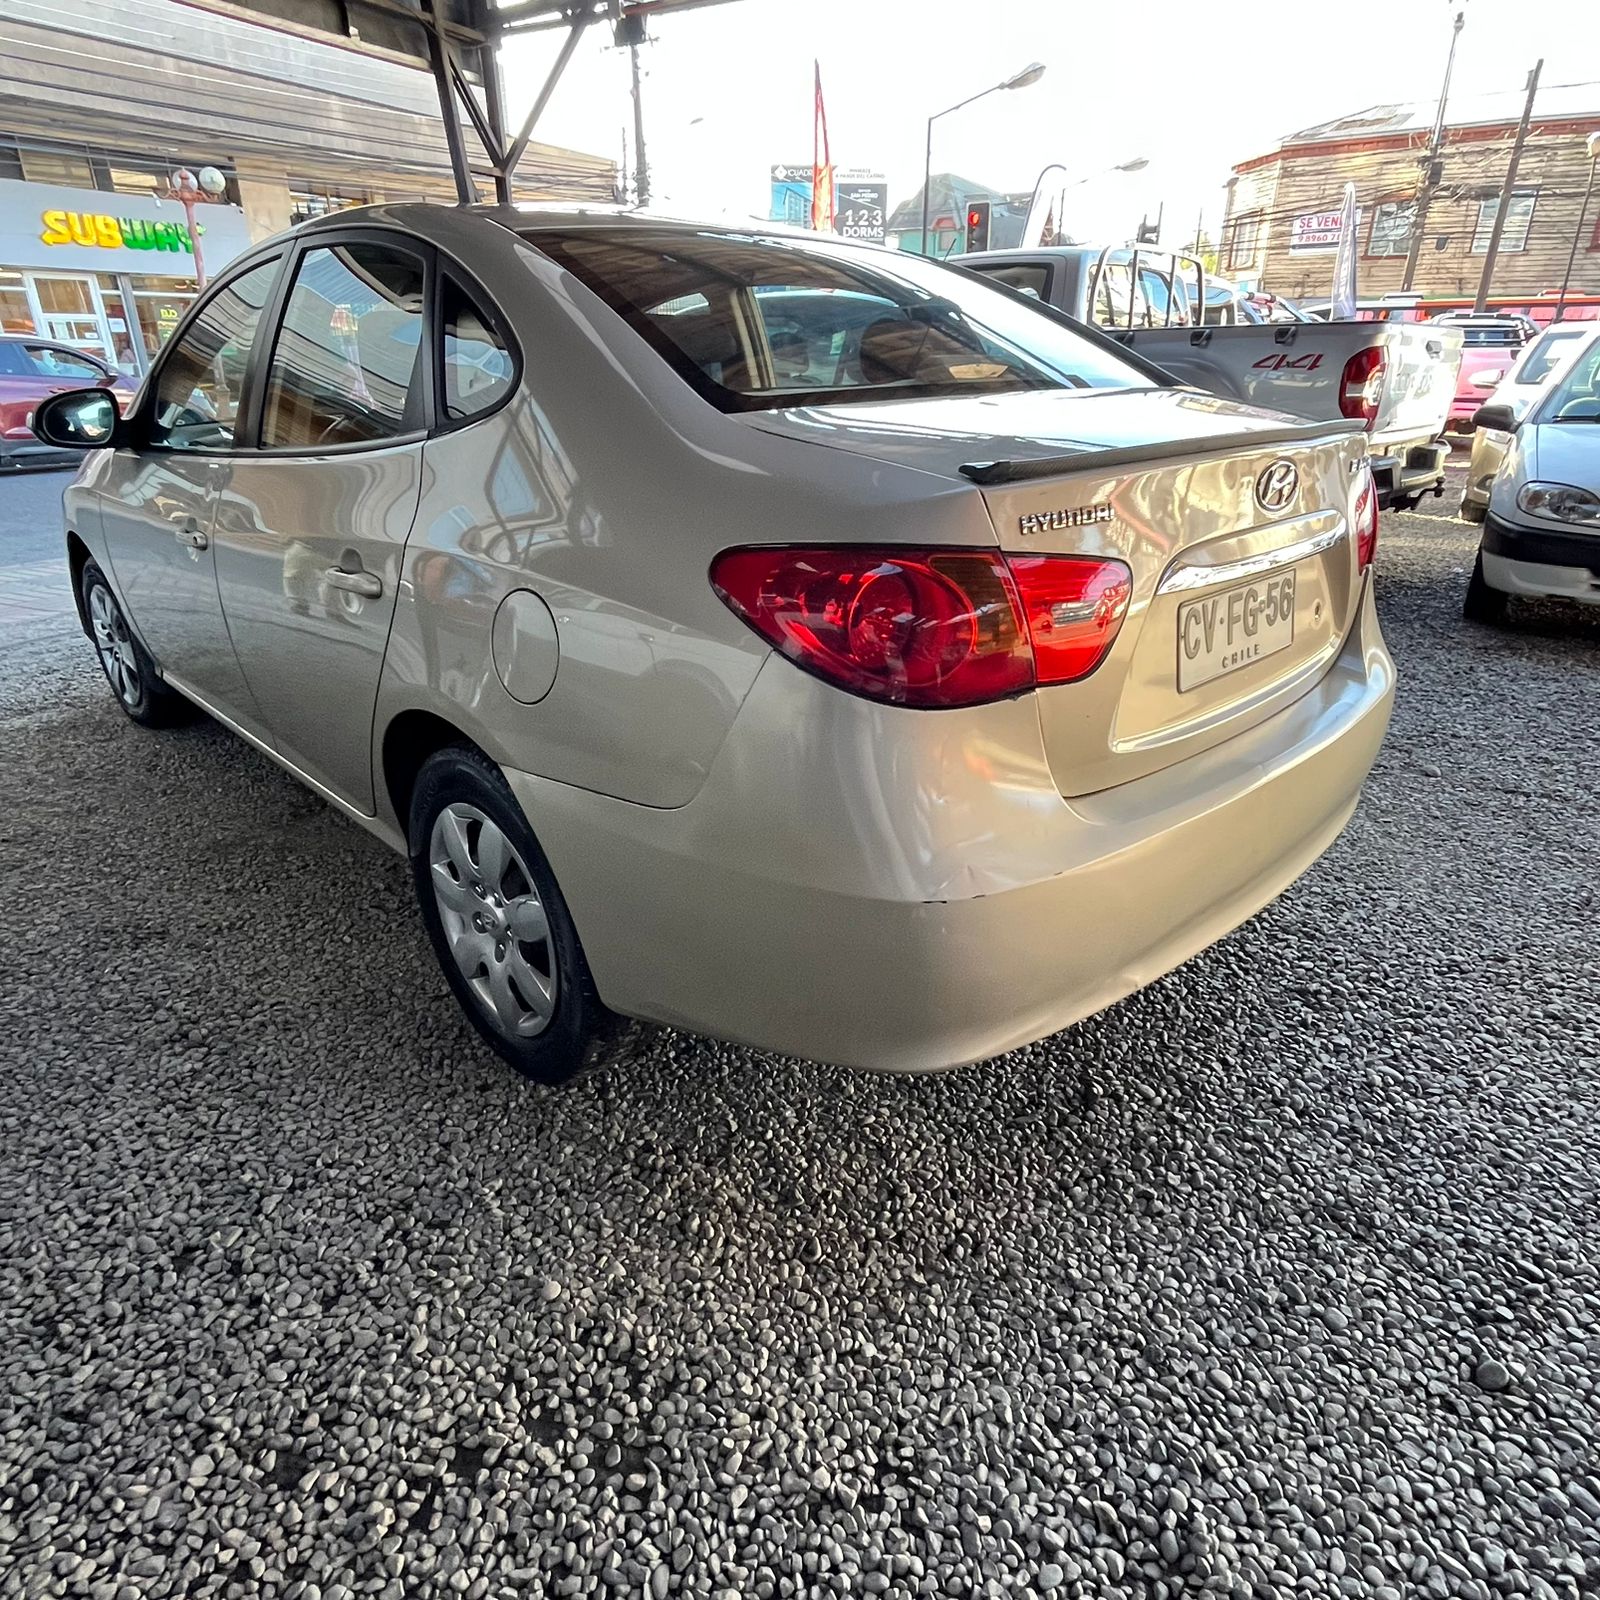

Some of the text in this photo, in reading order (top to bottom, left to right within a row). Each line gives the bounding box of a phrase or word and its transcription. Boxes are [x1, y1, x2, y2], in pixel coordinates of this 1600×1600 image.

[41, 210, 207, 254] SUBWAY
[842, 226, 884, 238] DORMS
[1299, 216, 1314, 229] SE
[1019, 502, 1116, 535] HYUNDAI
[1221, 643, 1261, 669] CHILE
